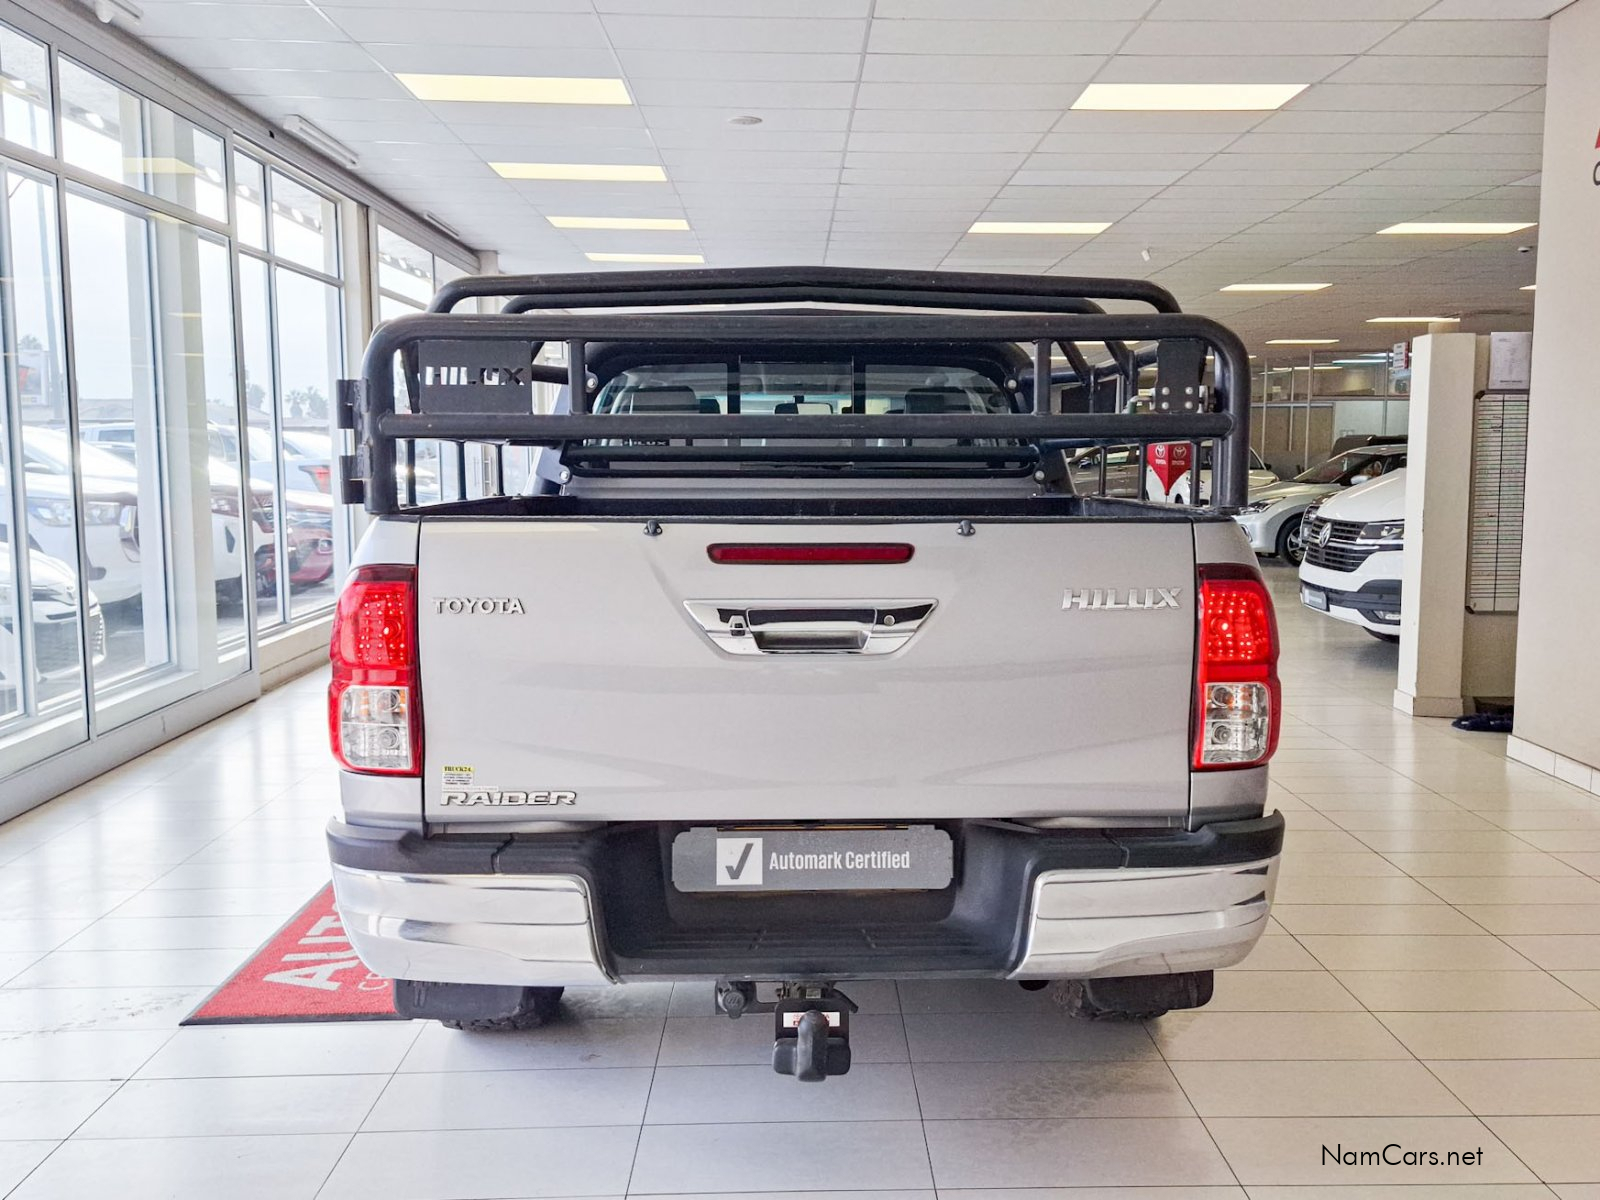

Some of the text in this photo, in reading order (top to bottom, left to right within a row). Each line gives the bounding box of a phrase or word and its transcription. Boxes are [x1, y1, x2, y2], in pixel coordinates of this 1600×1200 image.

[425, 366, 525, 386] HILUX
[432, 597, 526, 615] TOYOTA
[1061, 586, 1182, 611] HILUX
[440, 790, 577, 807] RAIDER
[769, 851, 910, 871] Automark Certified
